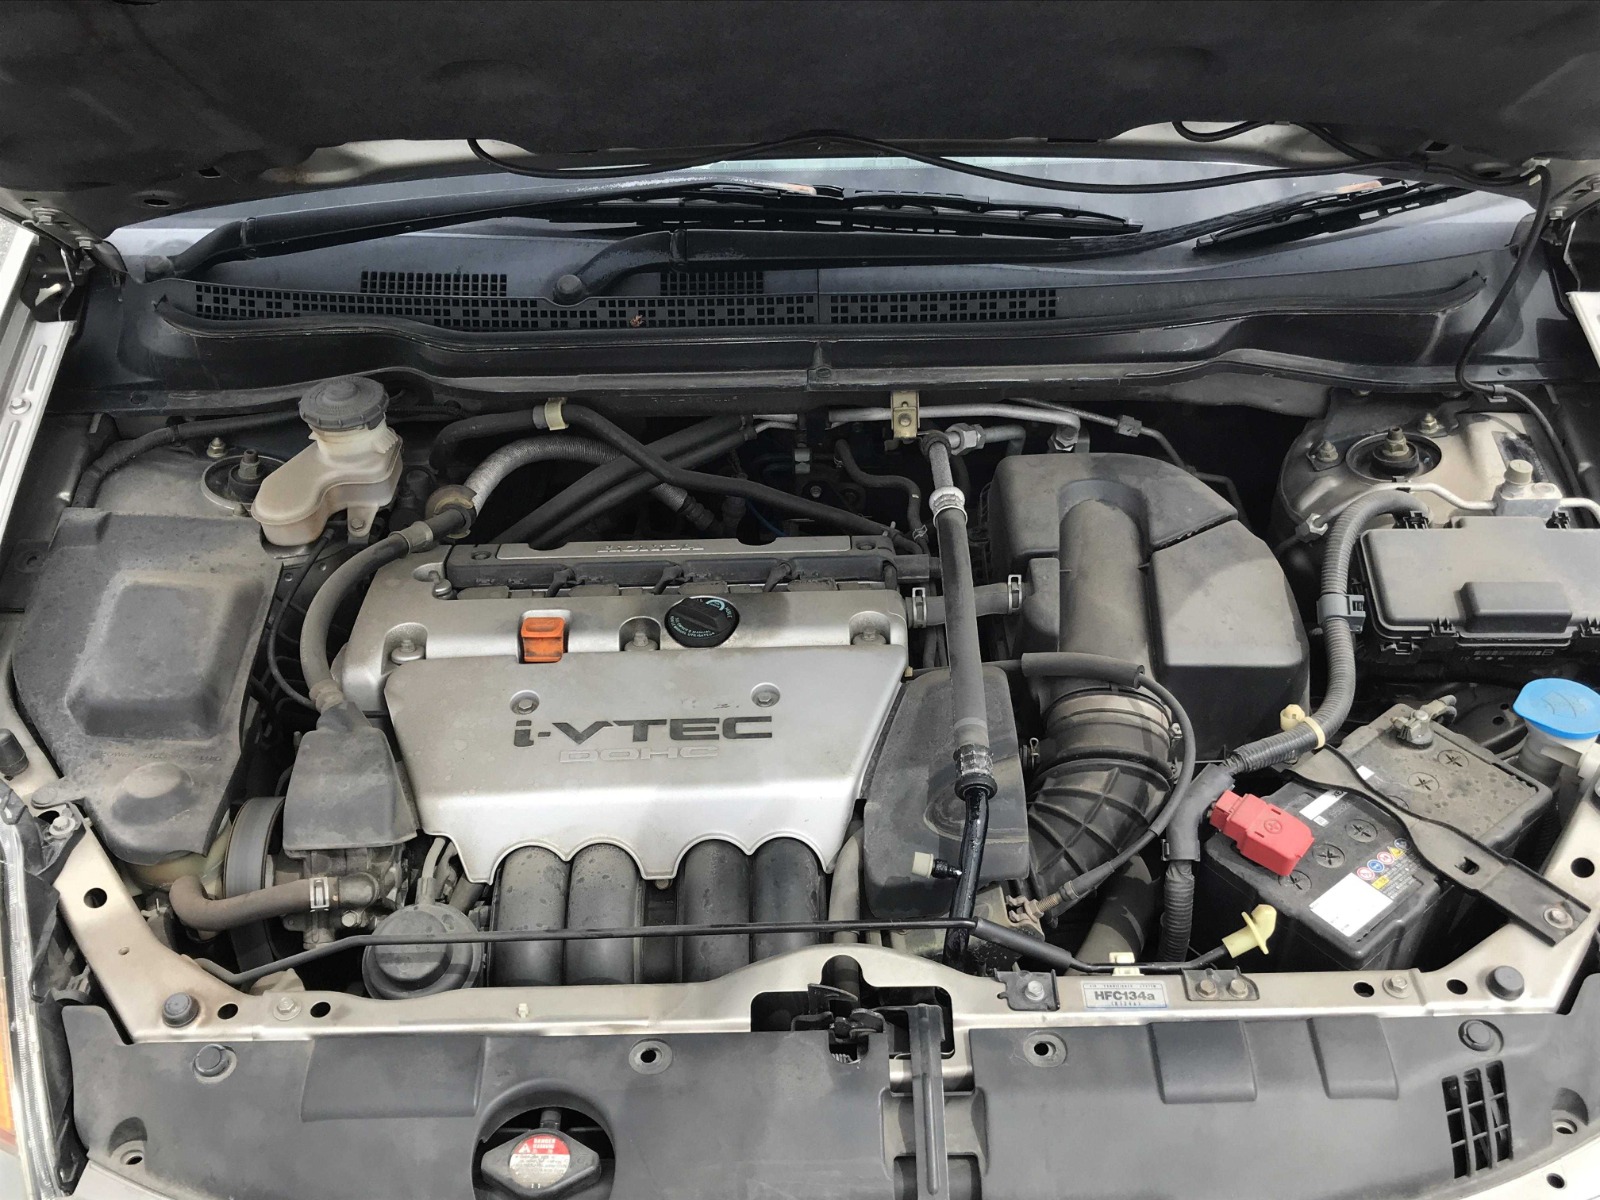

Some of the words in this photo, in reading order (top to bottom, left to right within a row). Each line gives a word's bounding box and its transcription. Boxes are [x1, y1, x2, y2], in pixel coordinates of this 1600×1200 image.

[513, 716, 772, 747] i-VTEC
[559, 746, 719, 763] DOHC
[1094, 991, 1155, 1000] HFC134a
